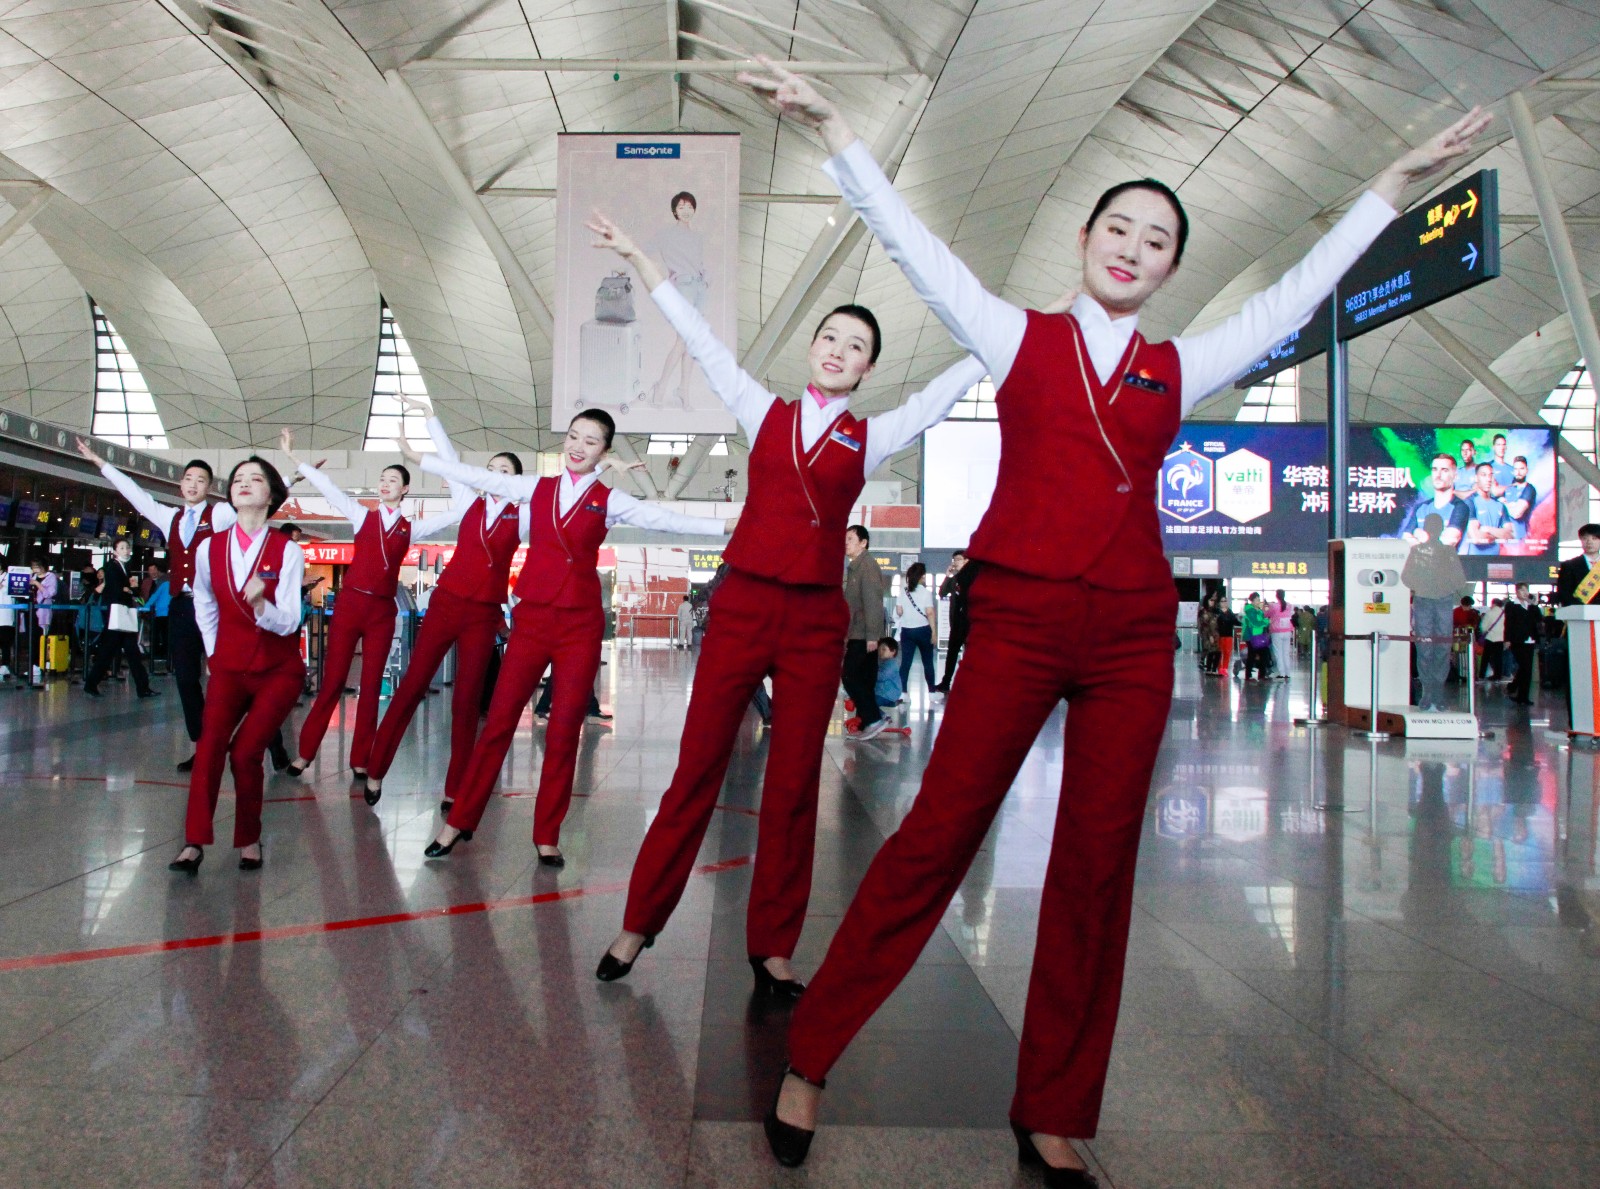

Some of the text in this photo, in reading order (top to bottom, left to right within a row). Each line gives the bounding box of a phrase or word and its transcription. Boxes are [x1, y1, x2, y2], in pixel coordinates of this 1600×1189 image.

[623, 146, 673, 155] Samsonite
[1419, 226, 1444, 246] Ticketing
[1353, 292, 1412, 324] 96833 Member Rest Area
[1225, 468, 1263, 482] vatti
[1168, 499, 1204, 507] FRANCE
[318, 548, 338, 560] VIP
[1298, 562, 1308, 575] 8
